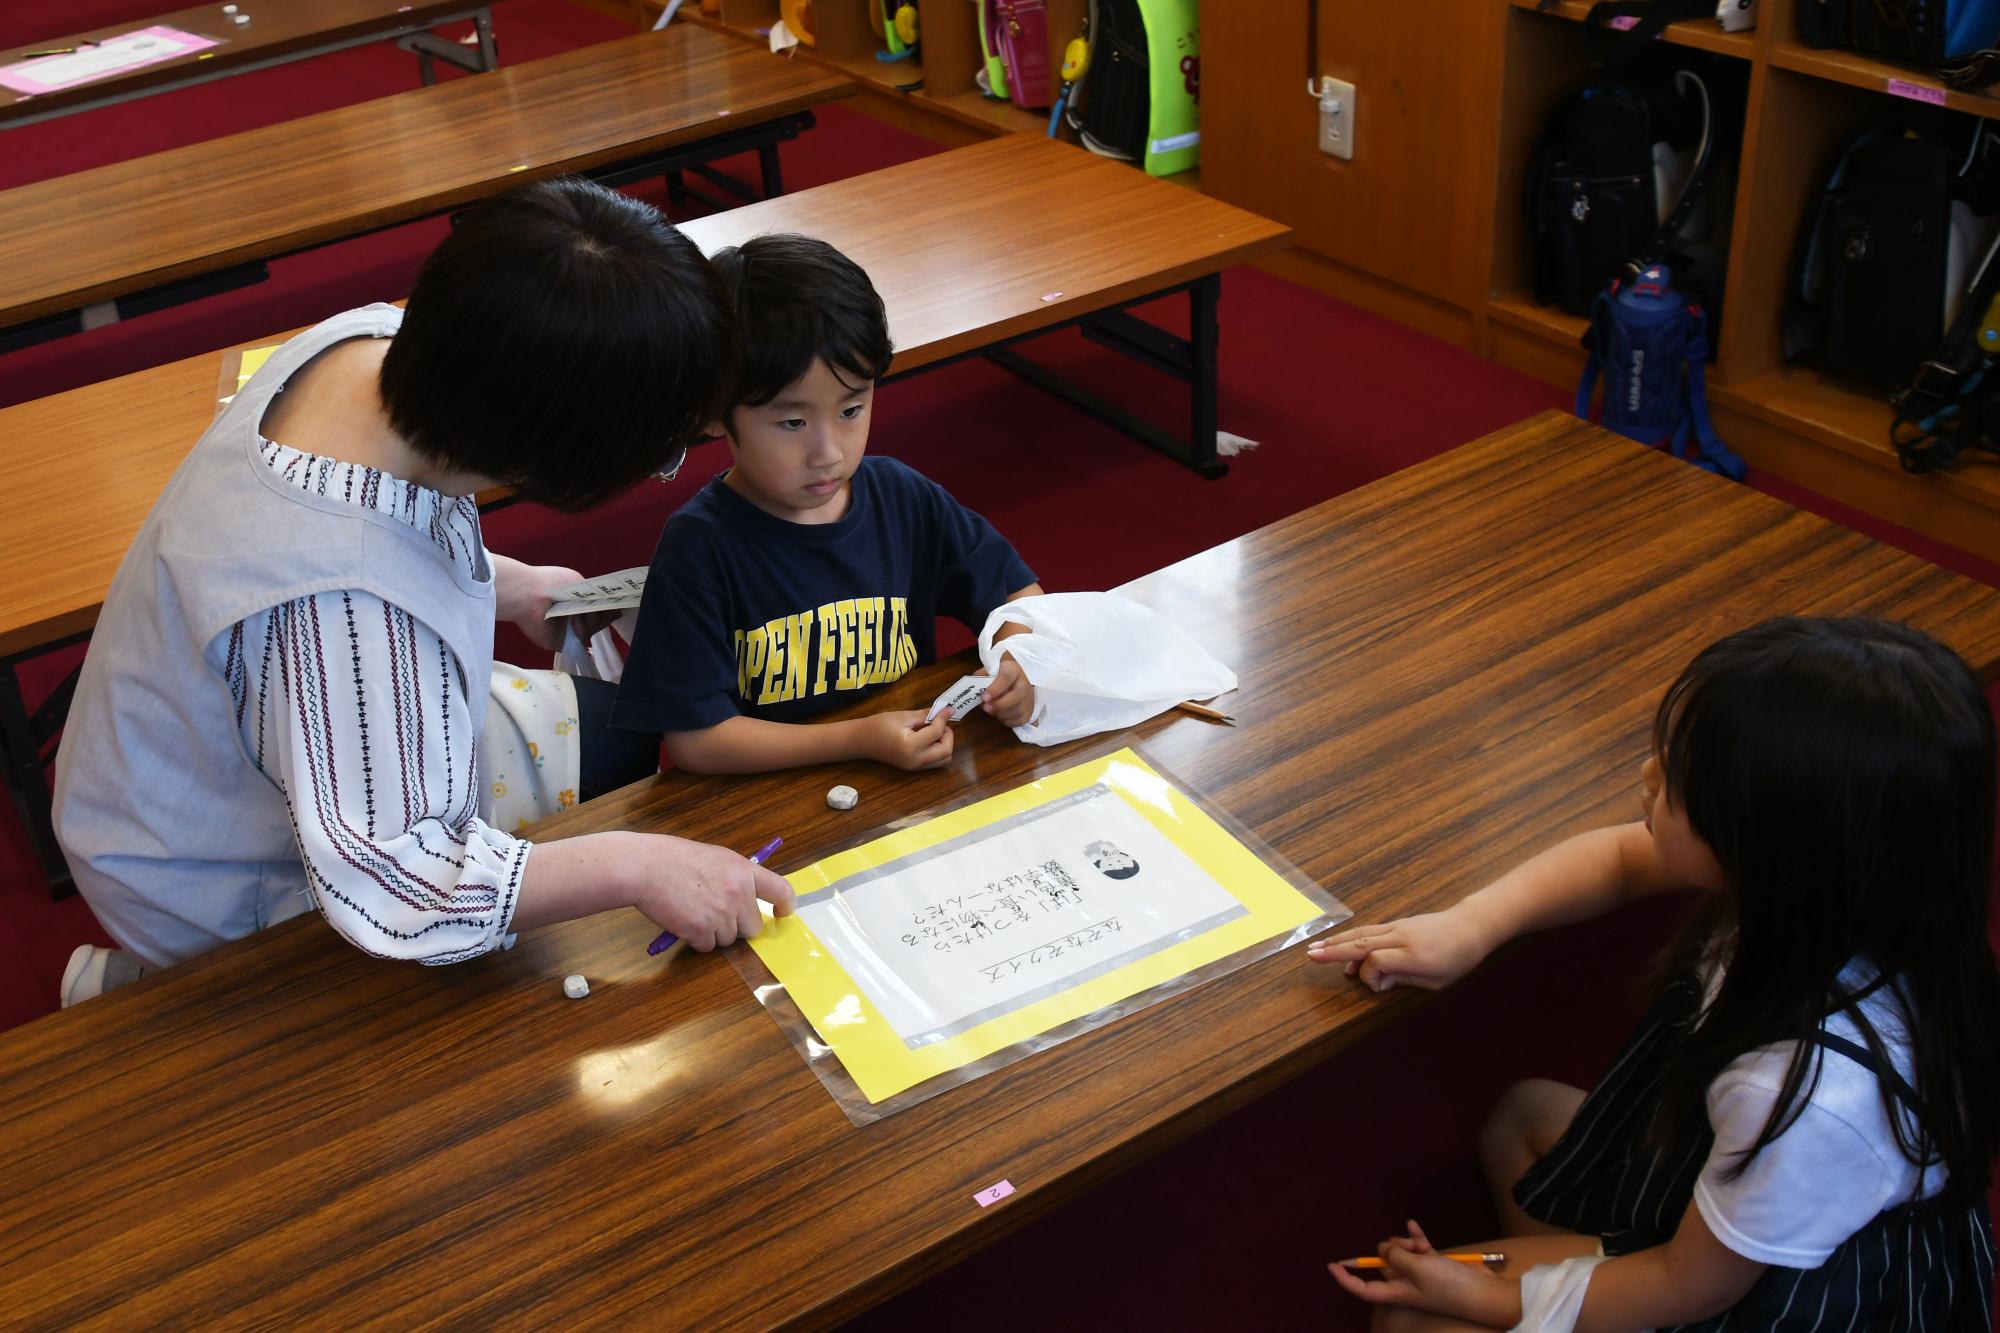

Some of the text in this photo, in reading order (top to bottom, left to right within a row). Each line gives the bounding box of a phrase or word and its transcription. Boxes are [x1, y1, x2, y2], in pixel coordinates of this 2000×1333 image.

[1629, 350, 1644, 411] SAHARA
[902, 871, 1077, 946] 黄色い食べ物になる
[984, 920, 1123, 983] なぞなぞクイズ
[989, 1188, 1000, 1198] 2
